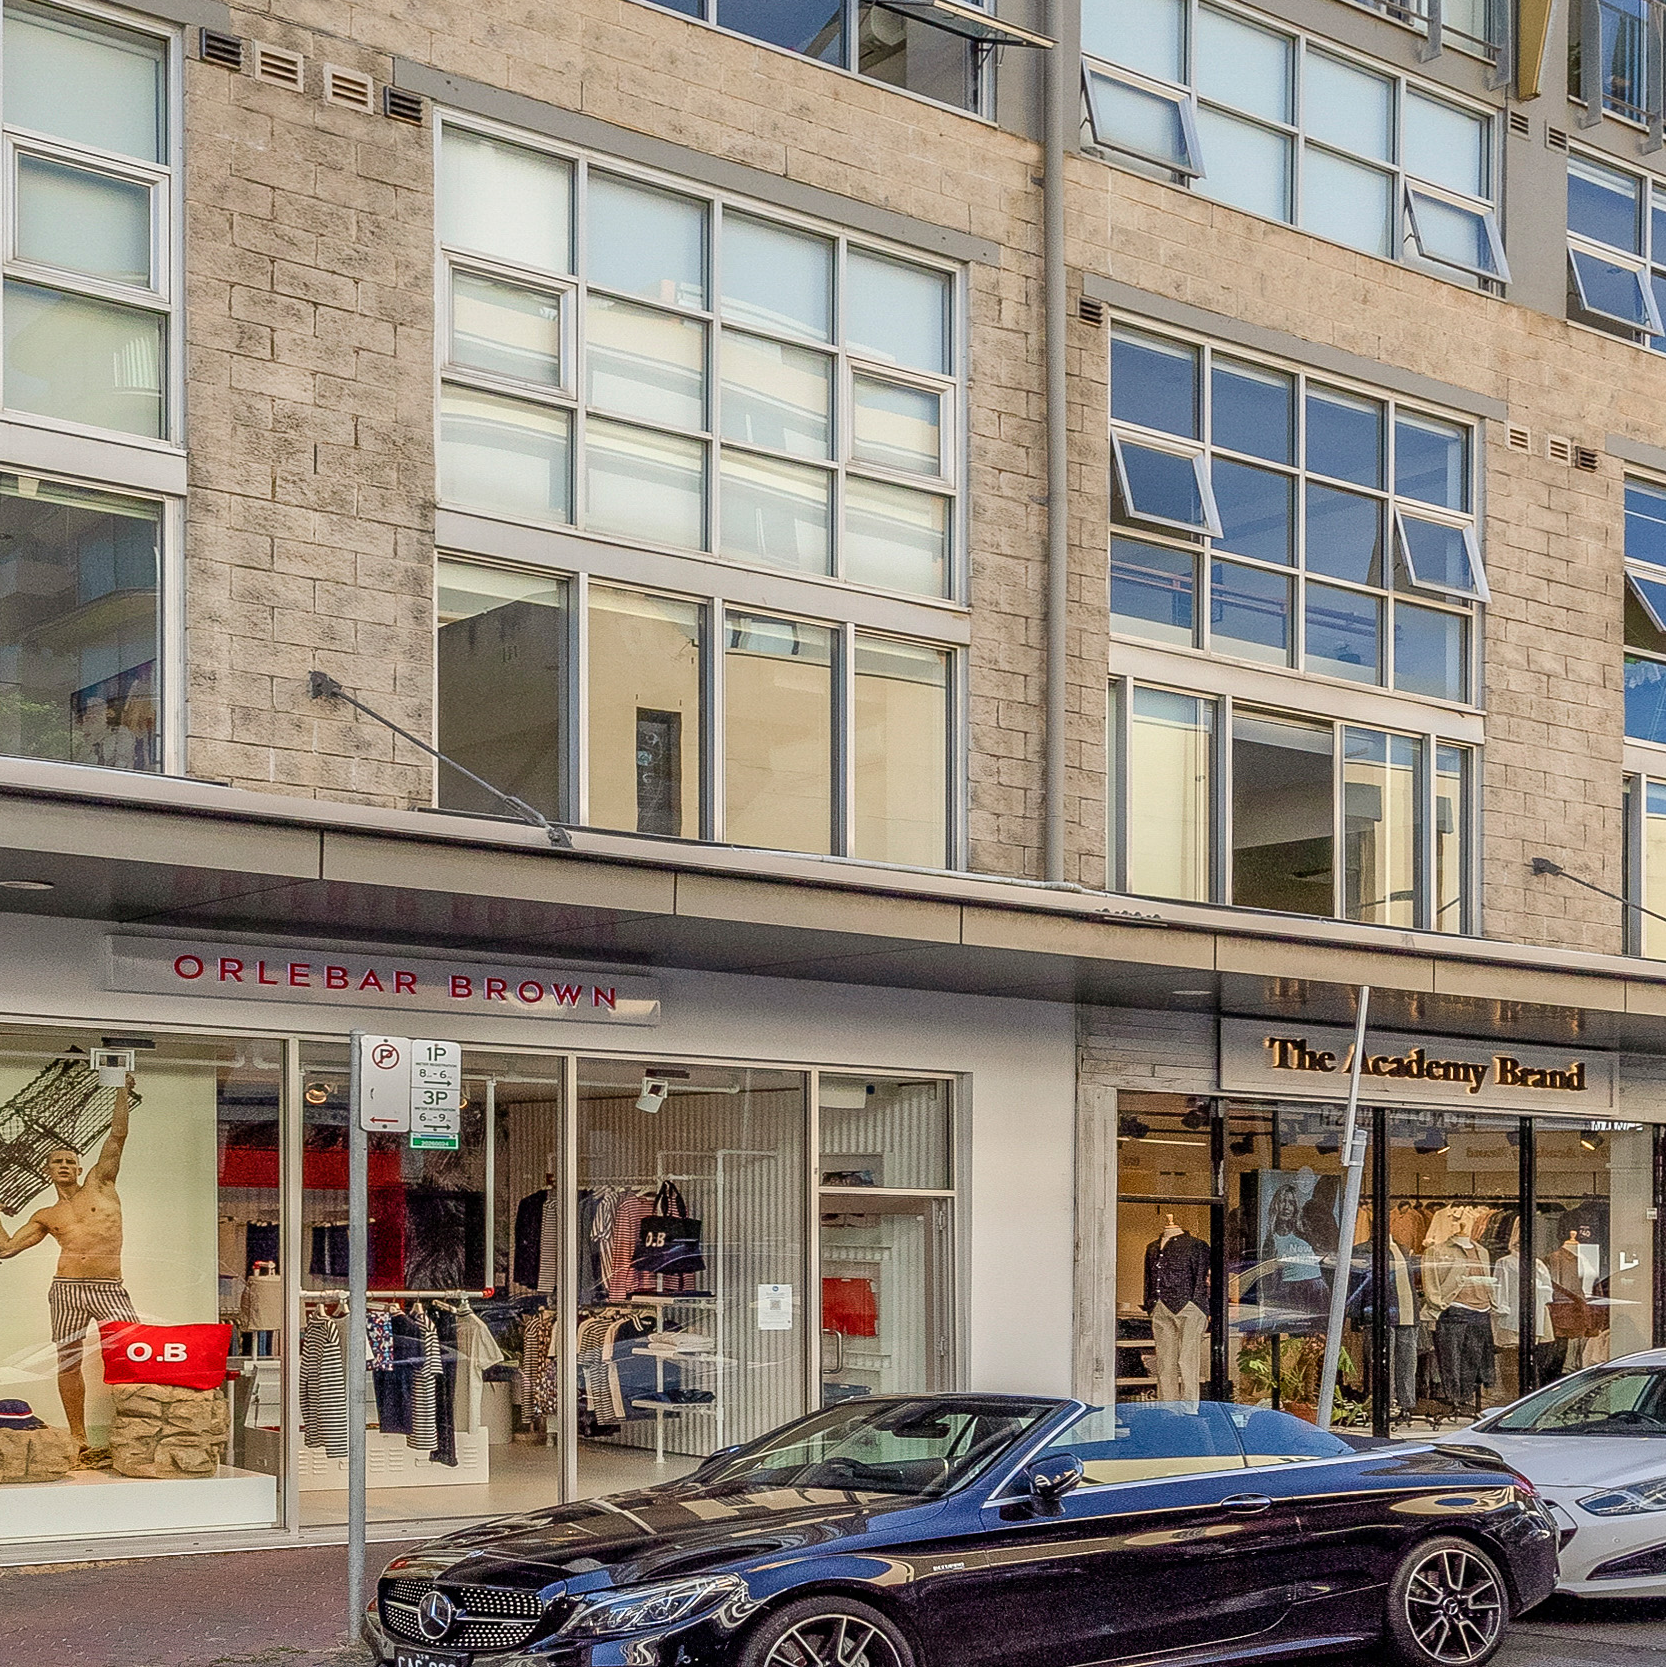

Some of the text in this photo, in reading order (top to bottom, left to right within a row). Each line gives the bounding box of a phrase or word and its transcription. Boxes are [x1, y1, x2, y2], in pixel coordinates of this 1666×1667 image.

[173, 954, 617, 1009] ORLEBAR BROWN
[427, 1047, 447, 1061] 1P
[1265, 1037, 1589, 1094] The Academy Brand
[423, 1090, 448, 1105] 3P
[645, 1231, 666, 1247] O.B
[126, 1342, 188, 1362] O.B
